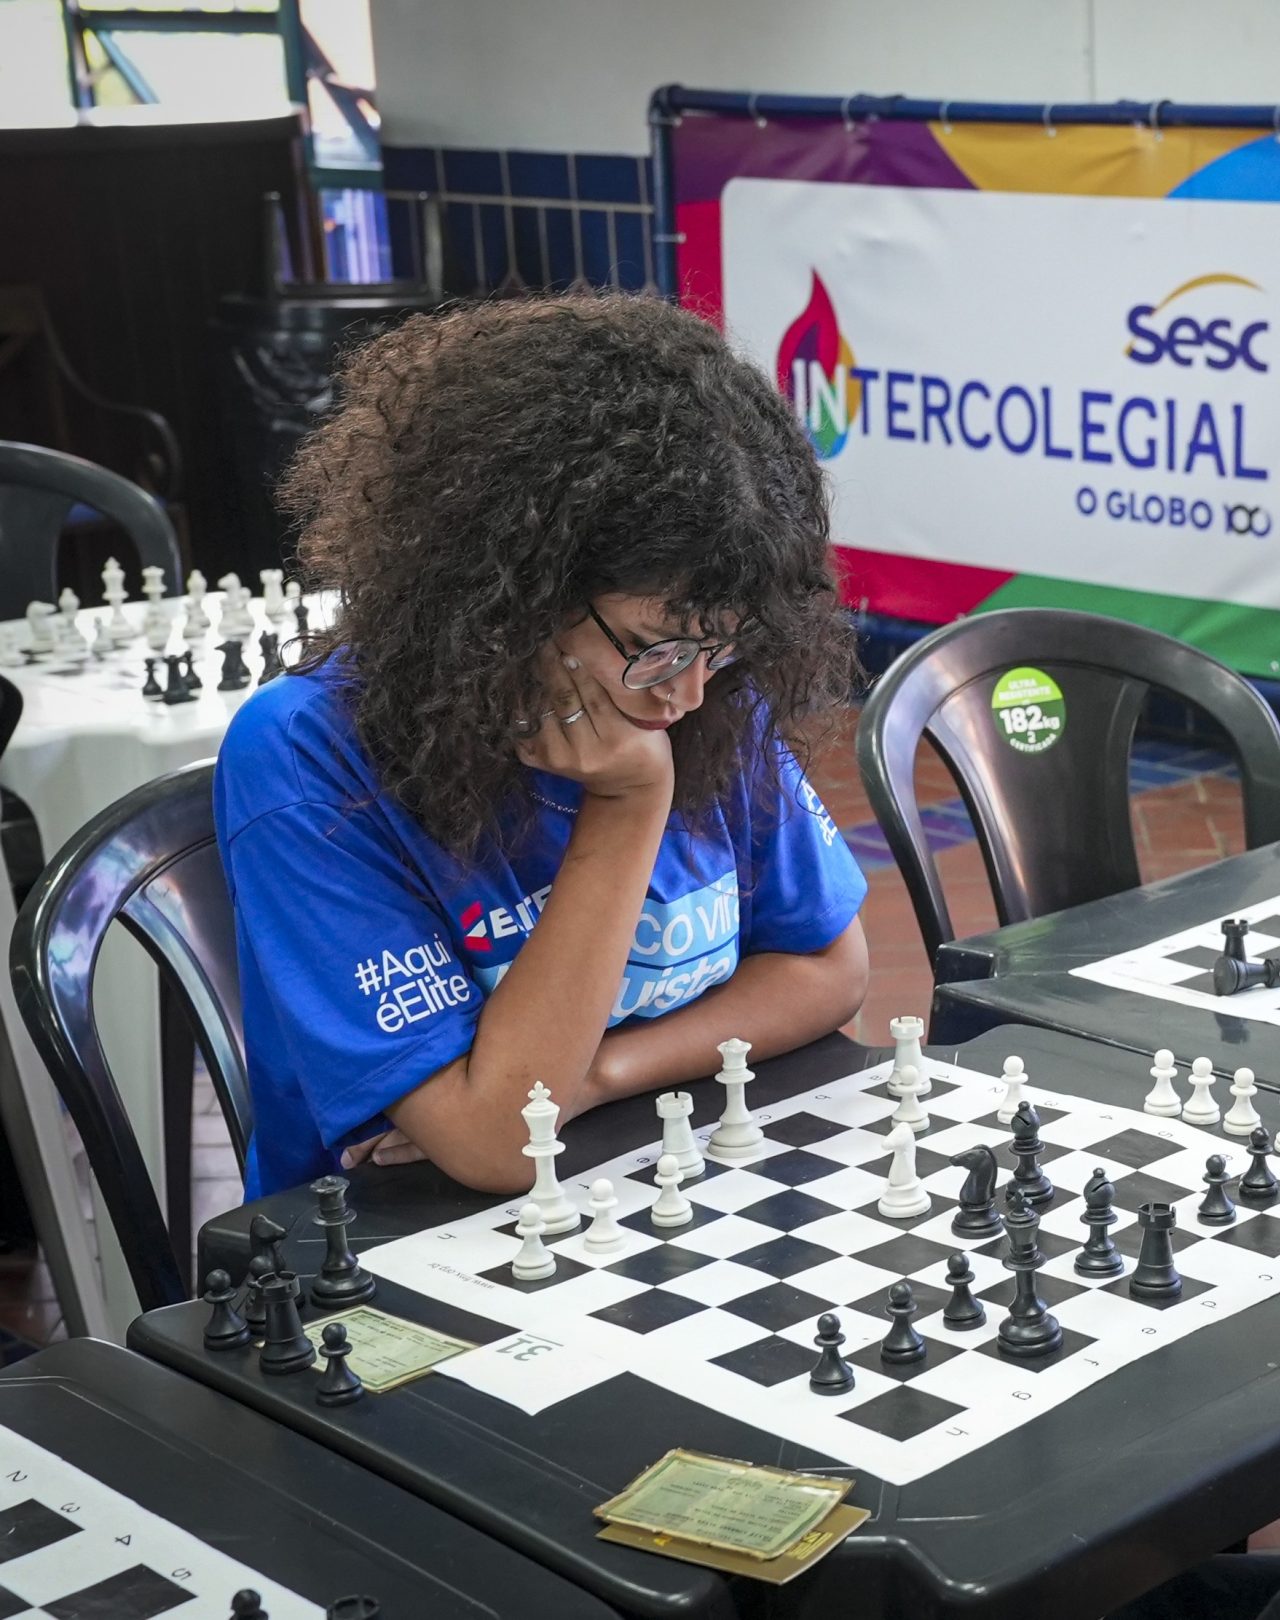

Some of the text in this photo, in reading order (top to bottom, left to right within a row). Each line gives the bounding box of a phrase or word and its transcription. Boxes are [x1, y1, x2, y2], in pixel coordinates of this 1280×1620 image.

[1126, 303, 1269, 373] Sesc
[792, 357, 1268, 480] INTERCOLEGIAL
[1076, 486, 1097, 515] O
[1106, 490, 1213, 530] GLOBO
[354, 933, 452, 996] #Aqui
[376, 974, 470, 1033] éElite
